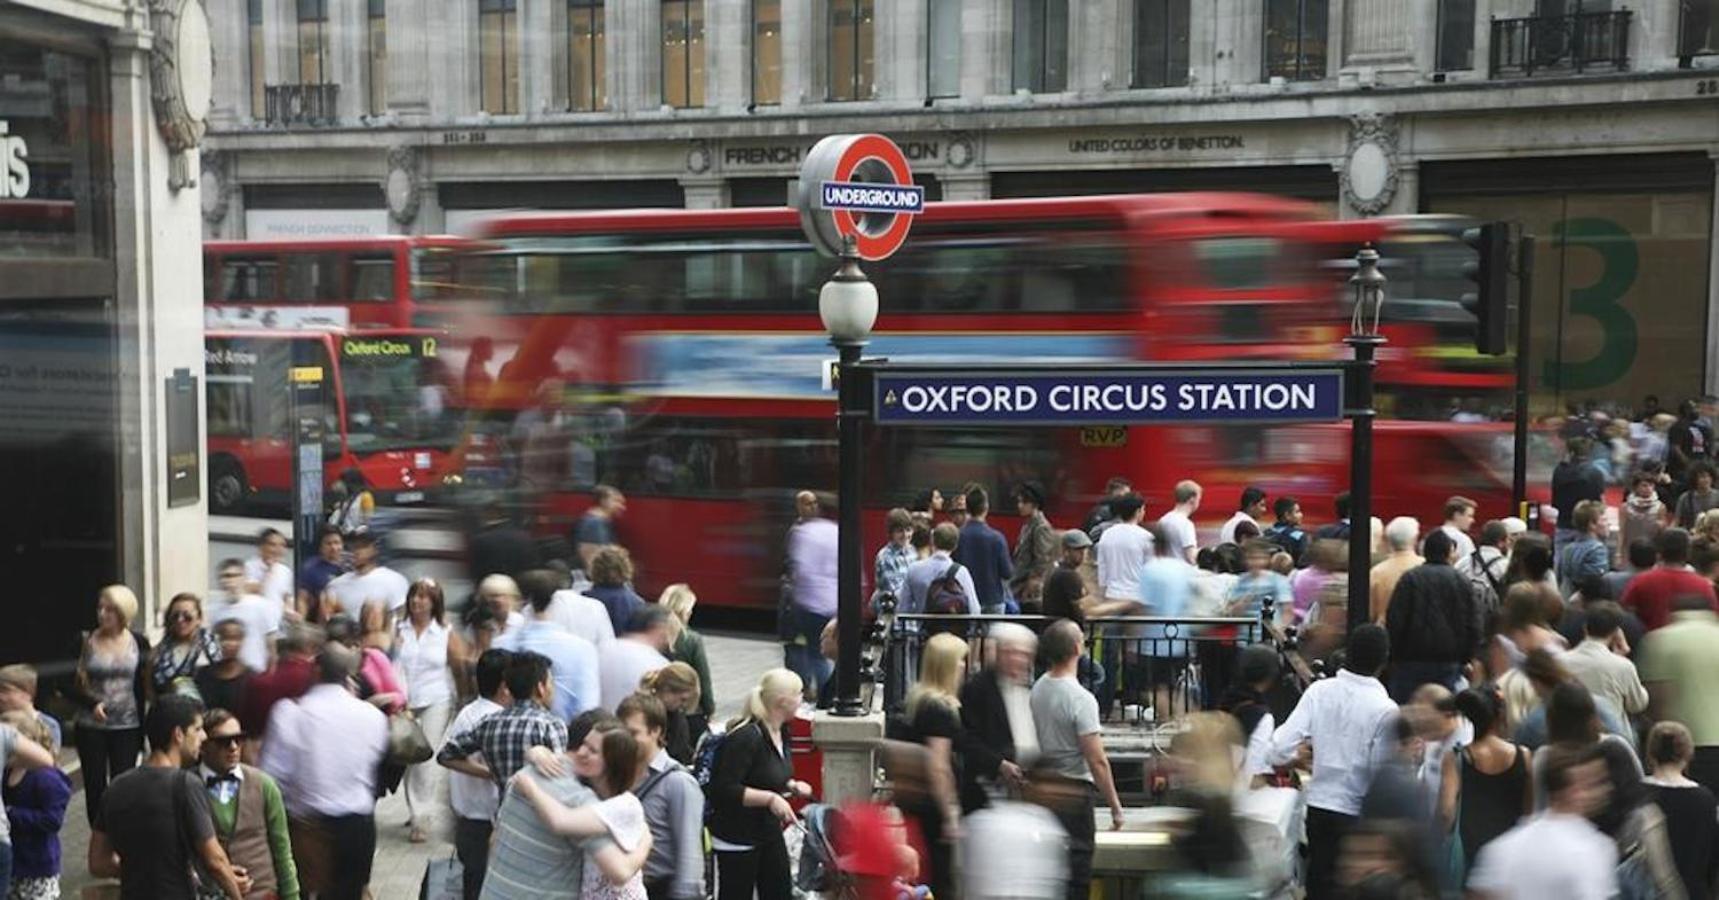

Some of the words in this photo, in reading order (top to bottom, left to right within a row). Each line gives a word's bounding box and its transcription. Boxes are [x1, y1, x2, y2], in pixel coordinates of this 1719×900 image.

[1069, 139, 1110, 153] UNITED
[1111, 138, 1158, 151] COLORS
[1160, 137, 1177, 150] OF
[725, 147, 799, 164] FRENCH
[825, 187, 919, 207] UNDERGROUND
[1543, 217, 1639, 391] 3
[344, 341, 380, 355] Oxford
[422, 336, 436, 356] 12
[902, 386, 1037, 412] OXFORD
[1049, 385, 1167, 412] CIRCUS
[1178, 383, 1316, 410] STATION
[1084, 429, 1124, 443] RVP
